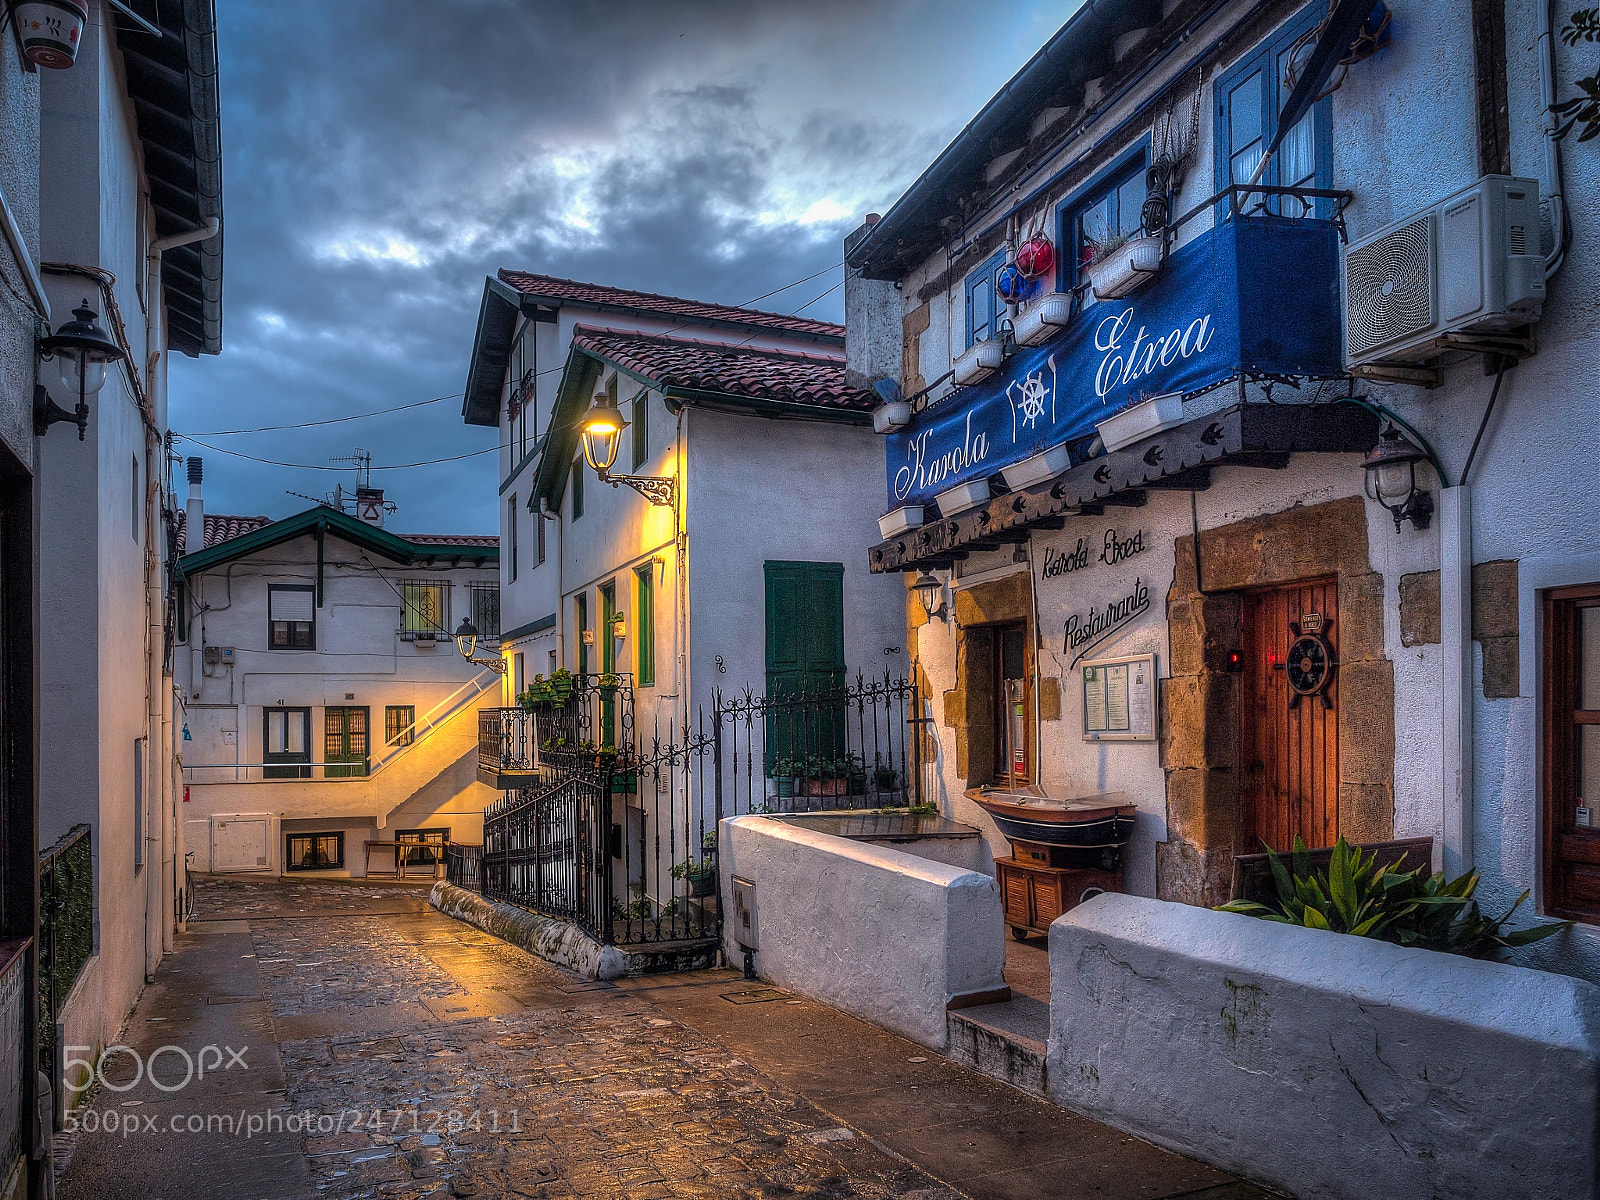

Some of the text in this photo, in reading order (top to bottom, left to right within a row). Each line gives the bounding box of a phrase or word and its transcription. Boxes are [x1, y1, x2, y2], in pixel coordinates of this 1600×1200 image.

[894, 307, 1215, 501] Karola Etxea
[1042, 528, 1146, 580] Karola Etxea
[1063, 577, 1151, 655] Restaurante
